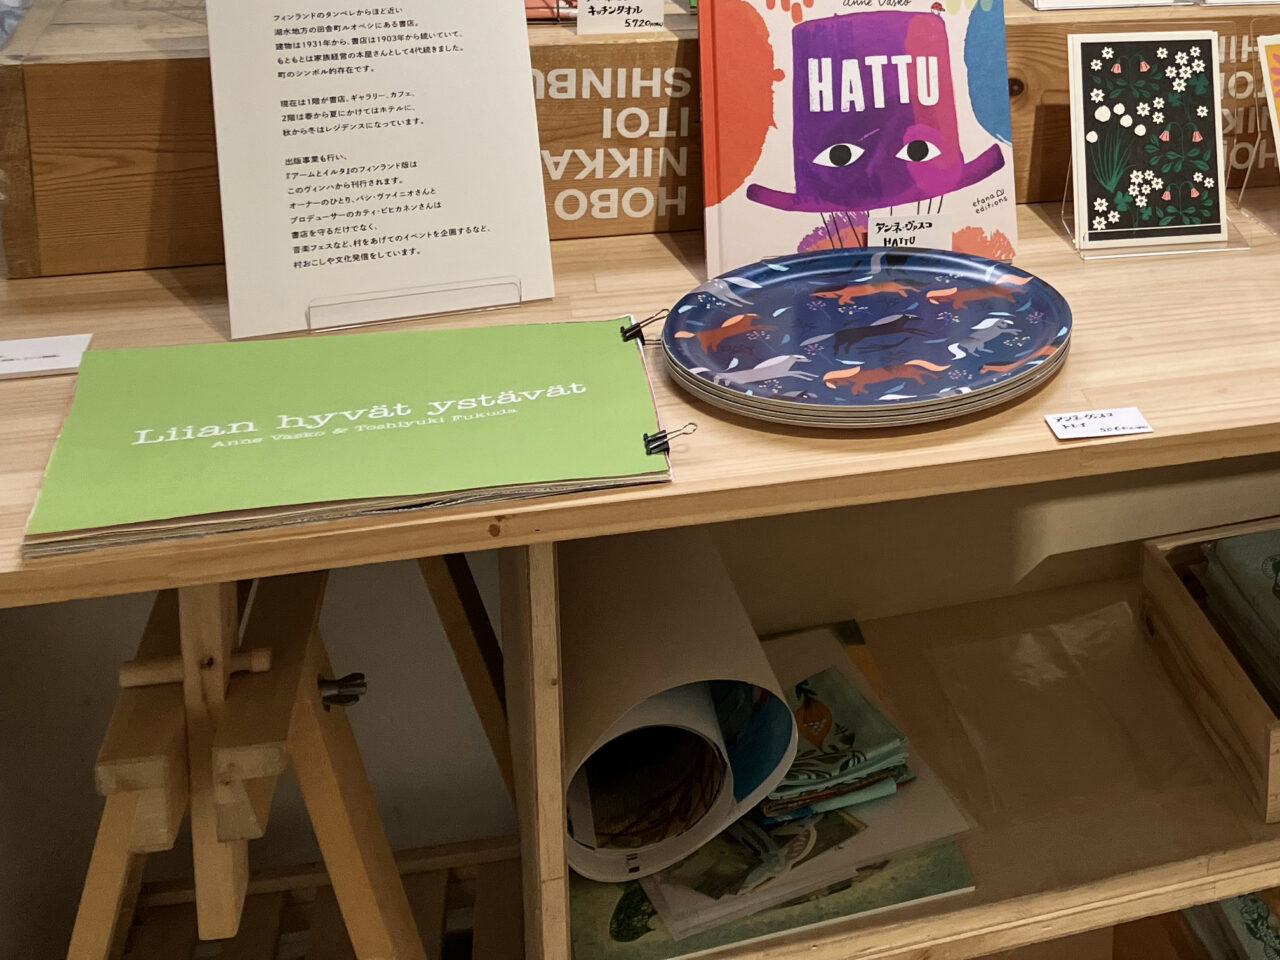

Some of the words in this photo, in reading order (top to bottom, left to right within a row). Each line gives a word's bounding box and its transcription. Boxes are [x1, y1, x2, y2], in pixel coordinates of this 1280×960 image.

[588, 5, 643, 16] キッチンタオル
[808, 55, 940, 113] HATTU
[602, 107, 690, 139] ITOI
[554, 185, 687, 221] HOBO
[972, 193, 996, 208] etana
[975, 195, 1008, 215] editions
[883, 236, 916, 247] HATTU
[131, 420, 259, 446] Liian
[276, 403, 412, 430] hyvät
[427, 382, 587, 416] ystävät
[211, 437, 264, 449] Anne
[272, 430, 326, 442] Vasko
[354, 417, 445, 432] Toshiyuki
[451, 408, 519, 423] Fukuda
